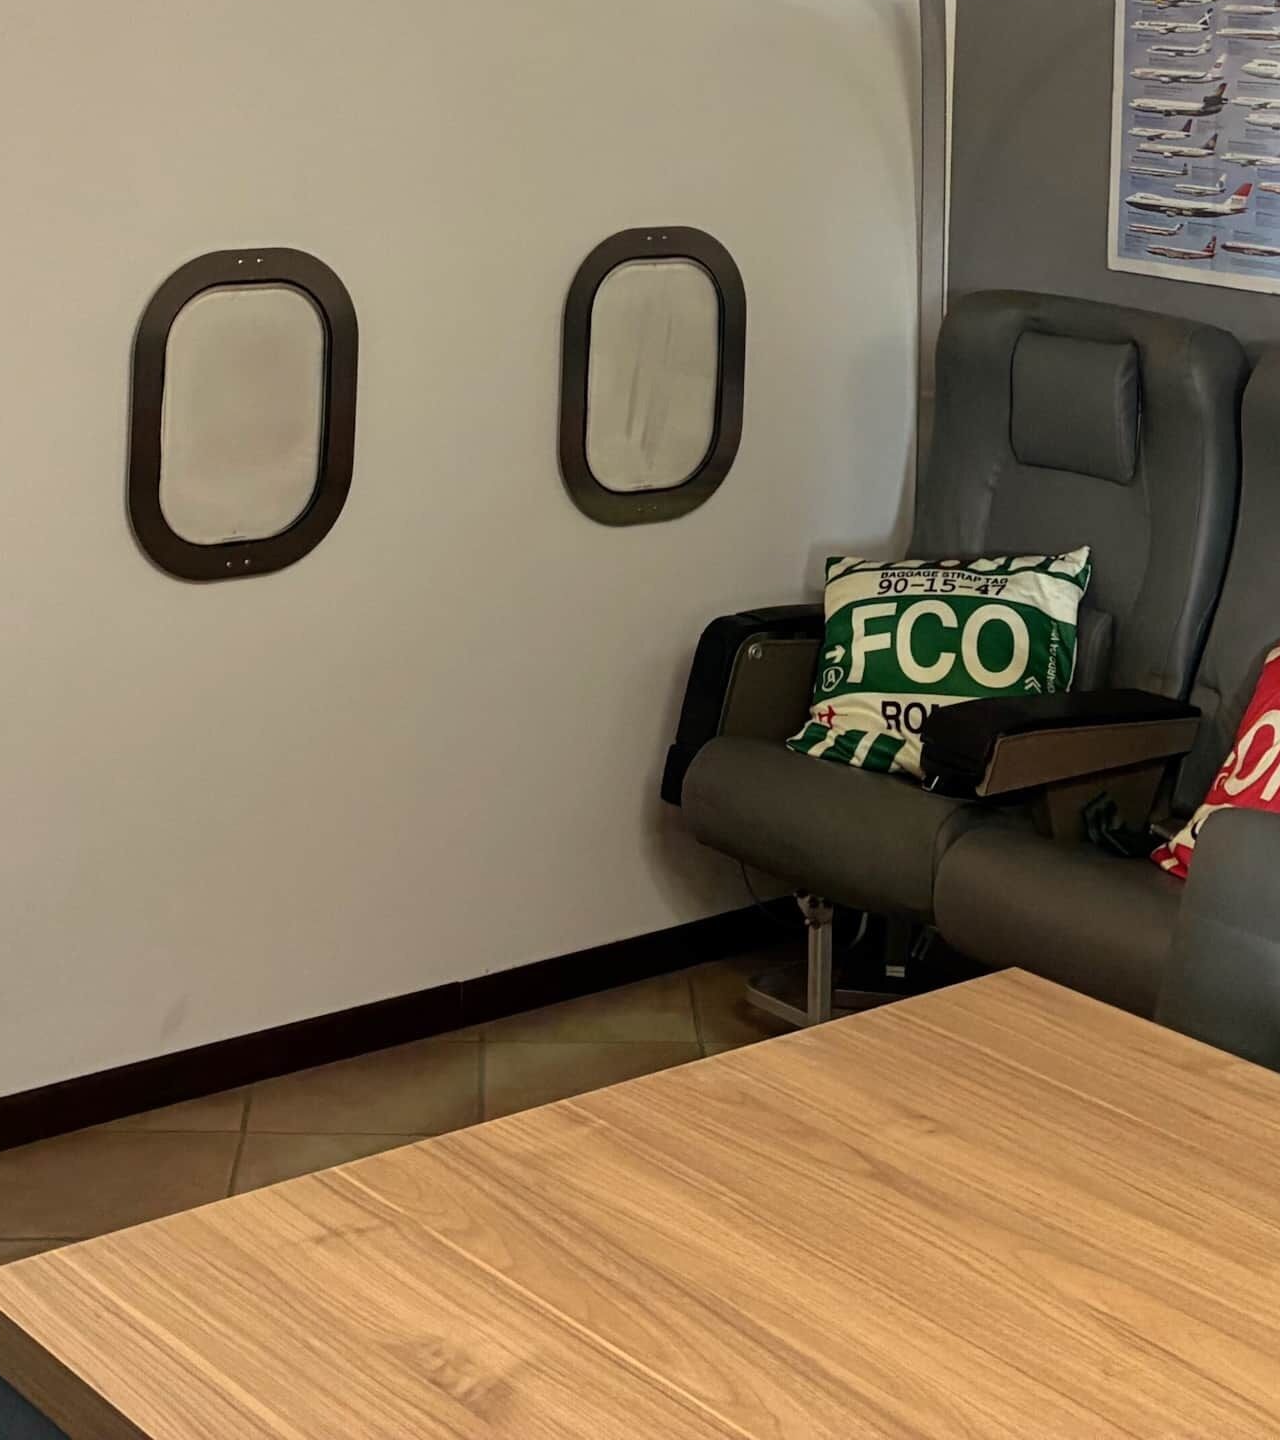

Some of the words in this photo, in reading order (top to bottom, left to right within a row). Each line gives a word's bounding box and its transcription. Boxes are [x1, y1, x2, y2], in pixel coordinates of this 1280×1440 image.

[880, 569, 939, 580] BAGGAGE
[941, 570, 983, 582] STRAP
[877, 577, 1008, 596] 90-15-47
[847, 599, 1030, 689] FCO
